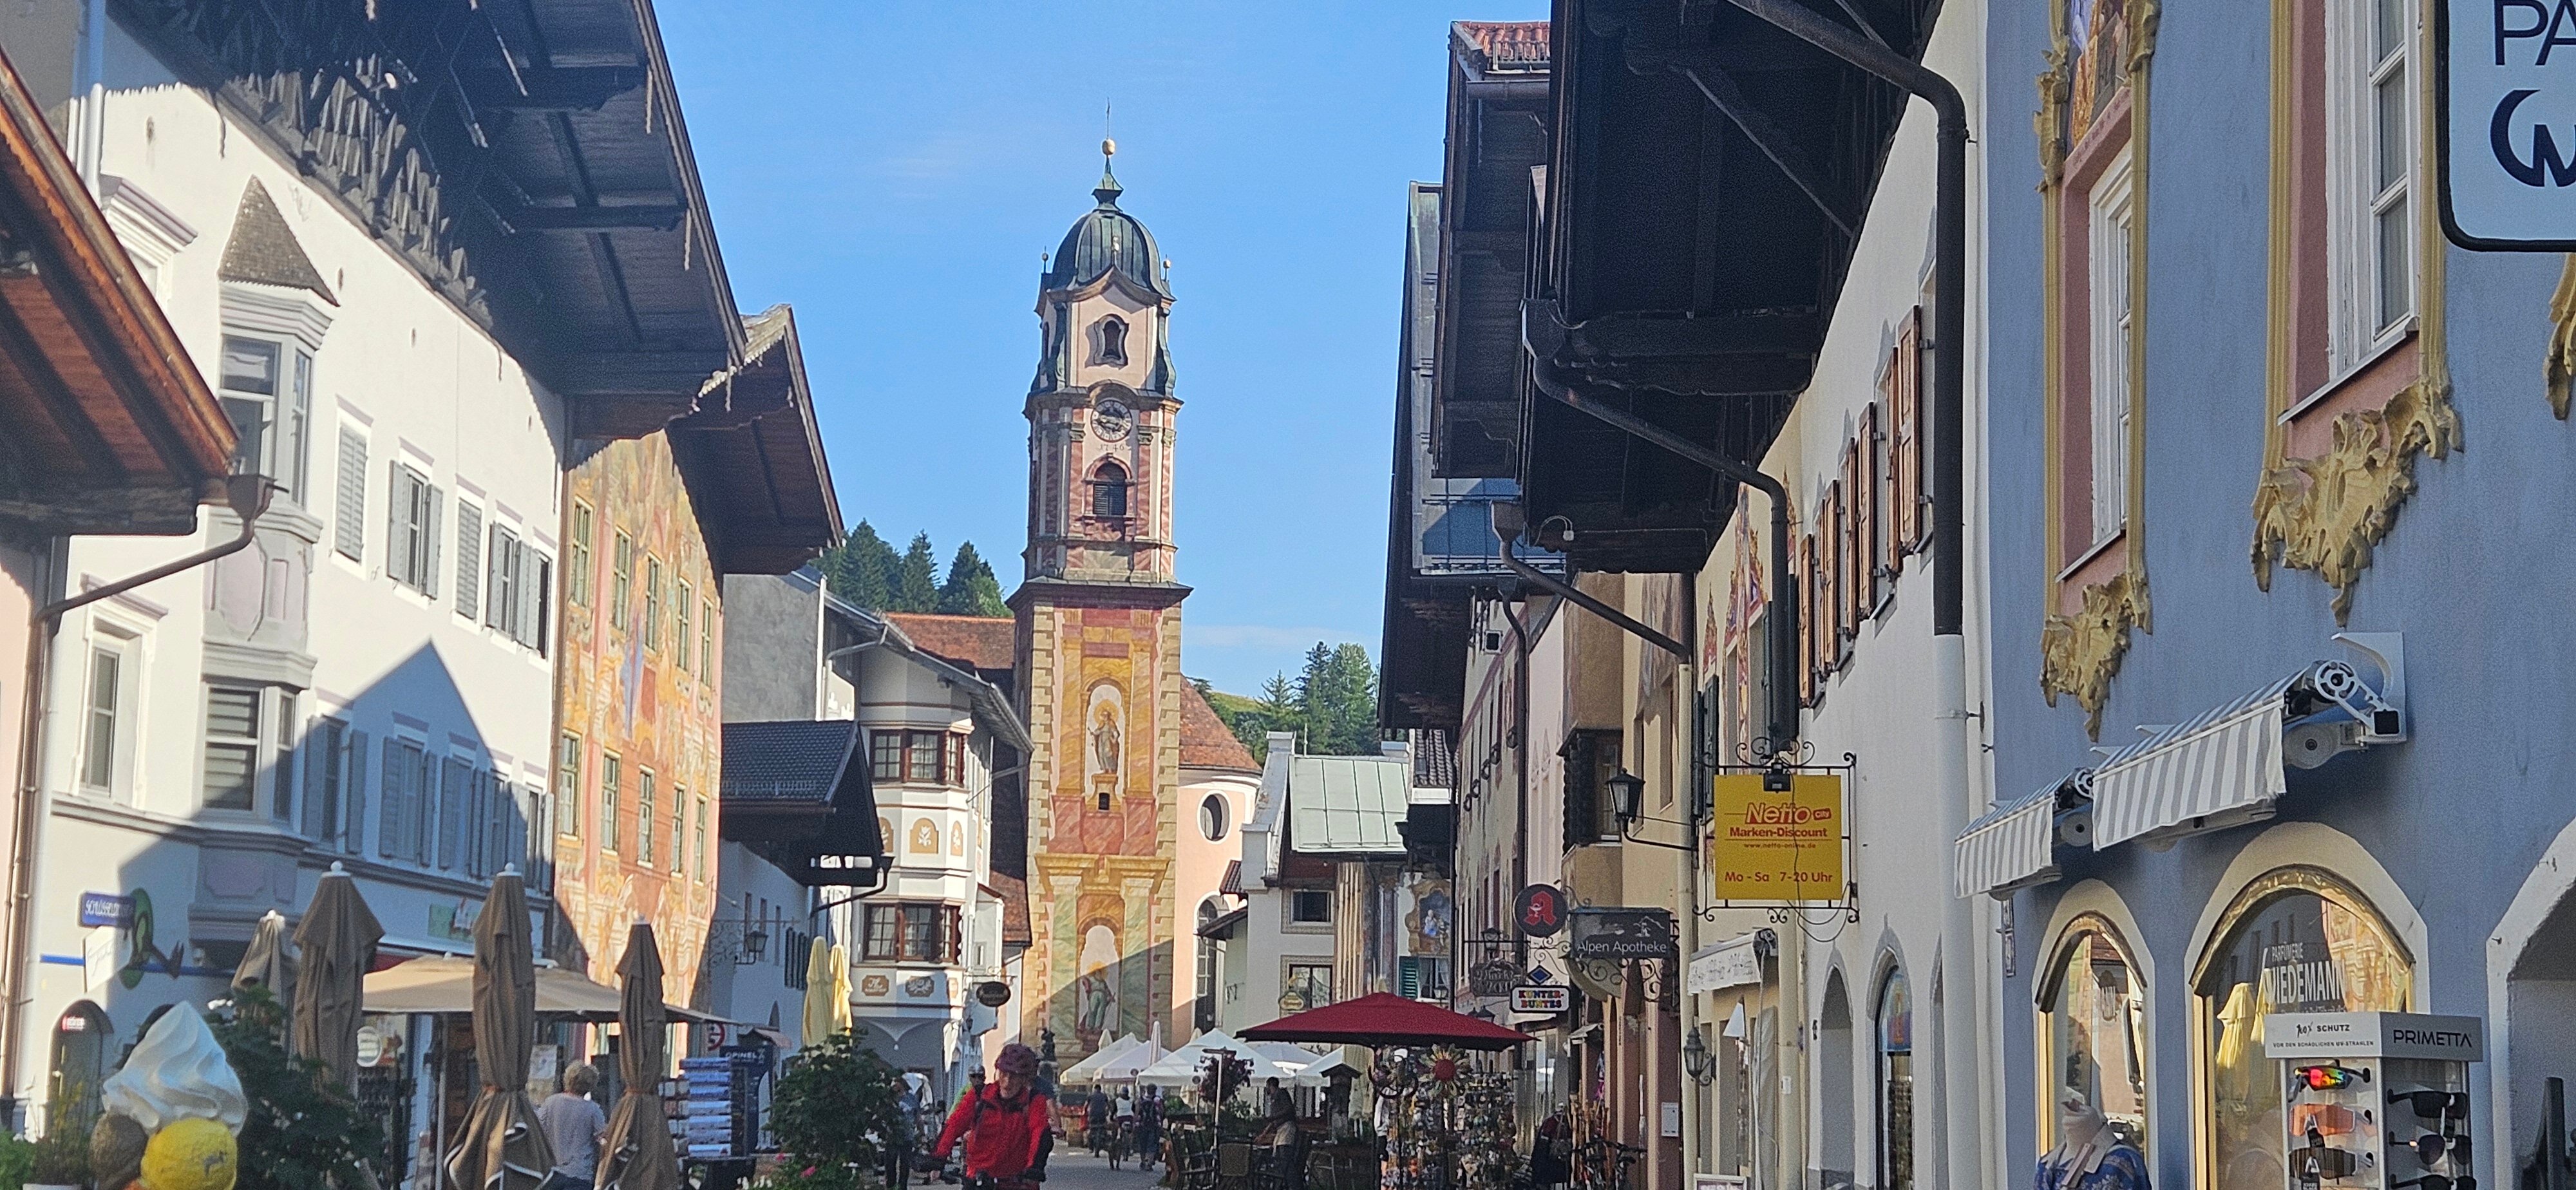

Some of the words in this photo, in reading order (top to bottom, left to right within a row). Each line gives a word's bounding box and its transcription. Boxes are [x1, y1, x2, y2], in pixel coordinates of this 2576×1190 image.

[1746, 802, 1811, 825] Netto
[1729, 827, 1828, 837] Marken-Discount
[1725, 872, 1744, 882] Mo
[1754, 872, 1770, 882] Sa
[1812, 872, 1833, 882] Uhr
[1577, 940, 1609, 955] Alpen
[1612, 940, 1667, 955] Apotheke
[1519, 990, 1564, 999] KUNTER-
[1521, 999, 1562, 1008] BUNTES
[2393, 1030, 2472, 1048] PRIMETTA
